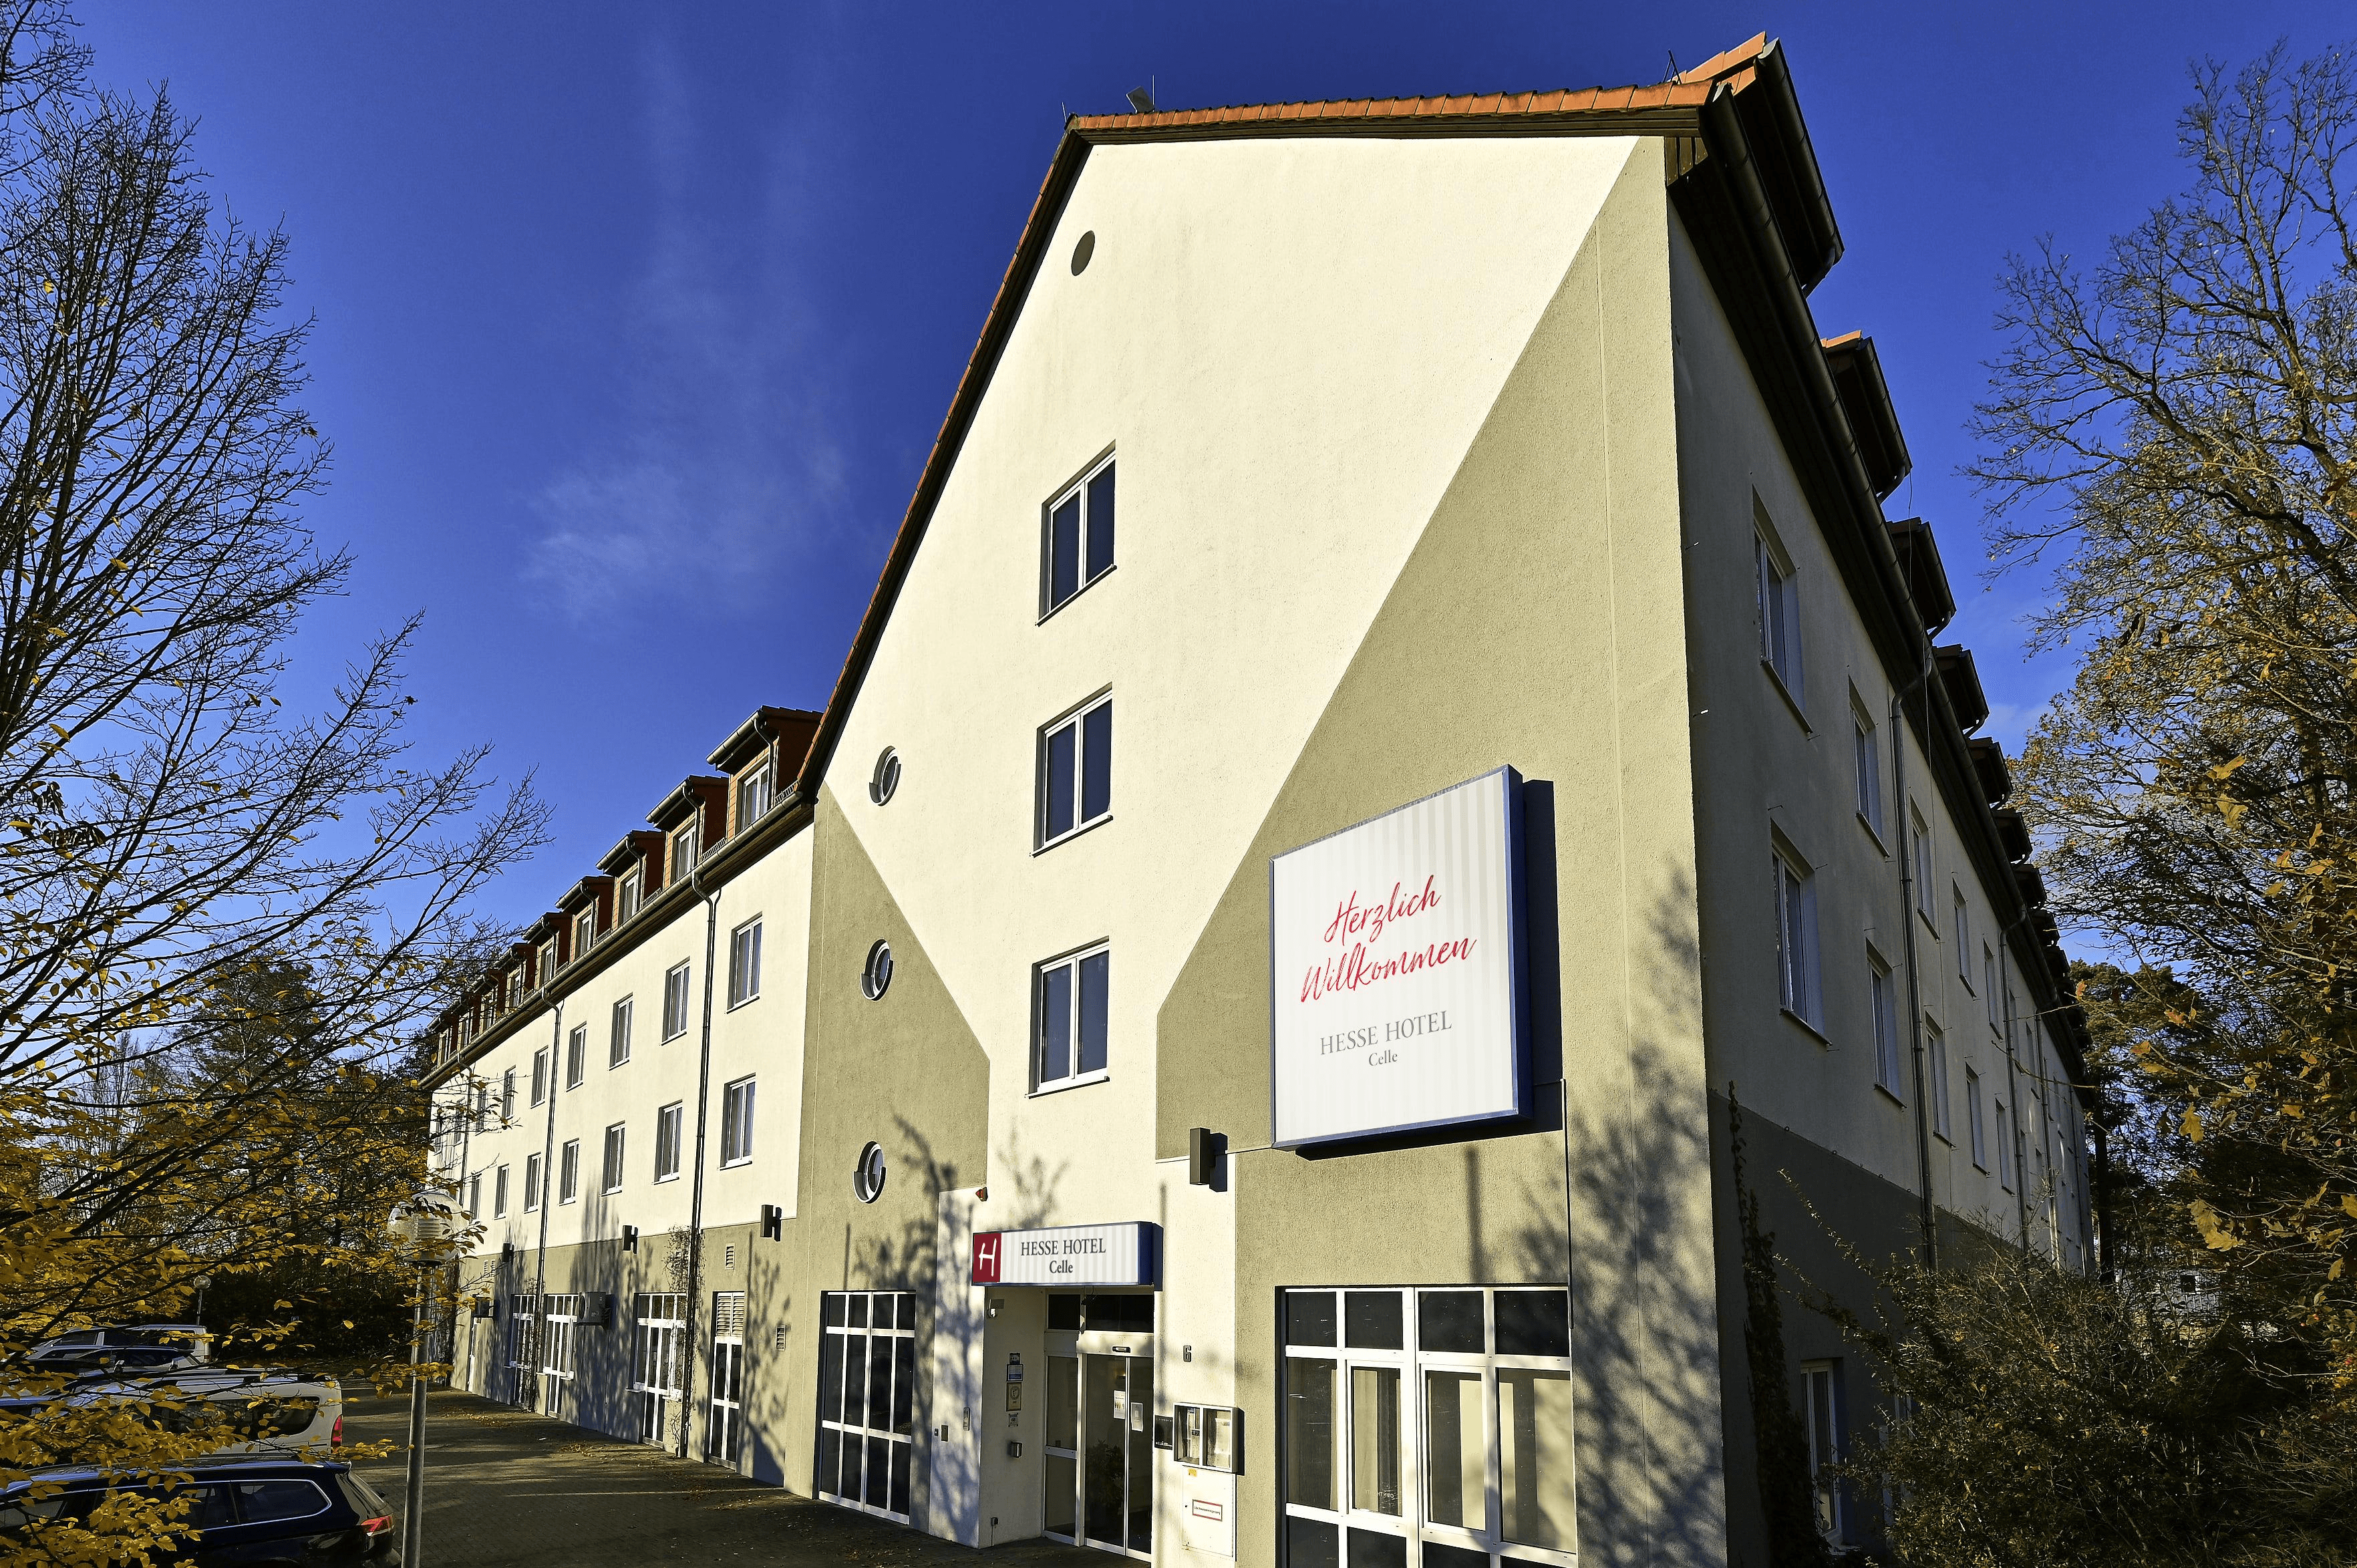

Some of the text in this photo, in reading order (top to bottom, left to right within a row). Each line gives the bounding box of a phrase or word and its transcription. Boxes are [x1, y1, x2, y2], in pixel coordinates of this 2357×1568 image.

[1324, 874, 1442, 946] Herzlich
[1301, 937, 1477, 1003] Willkommen
[1319, 1010, 1452, 1055] HESSE HOTEL
[1368, 1049, 1398, 1067] Celle
[978, 1237, 997, 1277] H
[1021, 1237, 1106, 1256] HESSE HOTEL
[1049, 1259, 1074, 1274] Celle
[1183, 1345, 1192, 1363] 6
